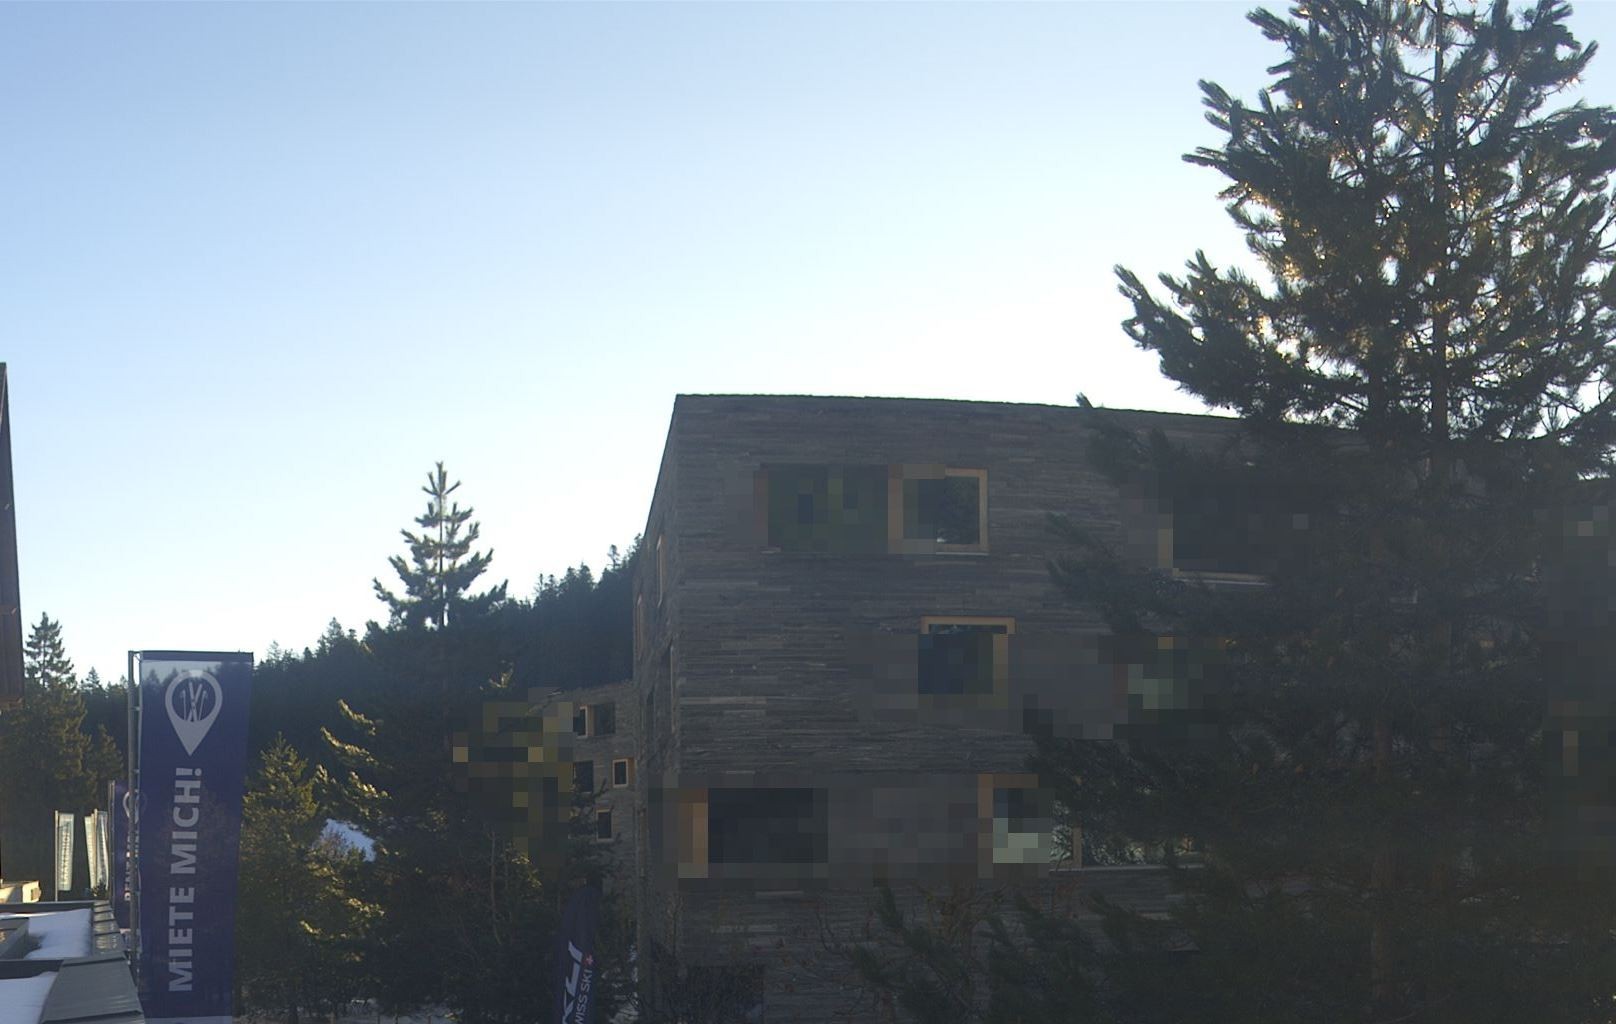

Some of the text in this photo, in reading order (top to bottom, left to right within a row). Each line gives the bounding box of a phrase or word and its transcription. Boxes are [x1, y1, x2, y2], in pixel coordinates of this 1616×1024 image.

[168, 767, 203, 992] MIETE MICH!
[580, 969, 593, 994] SKI
